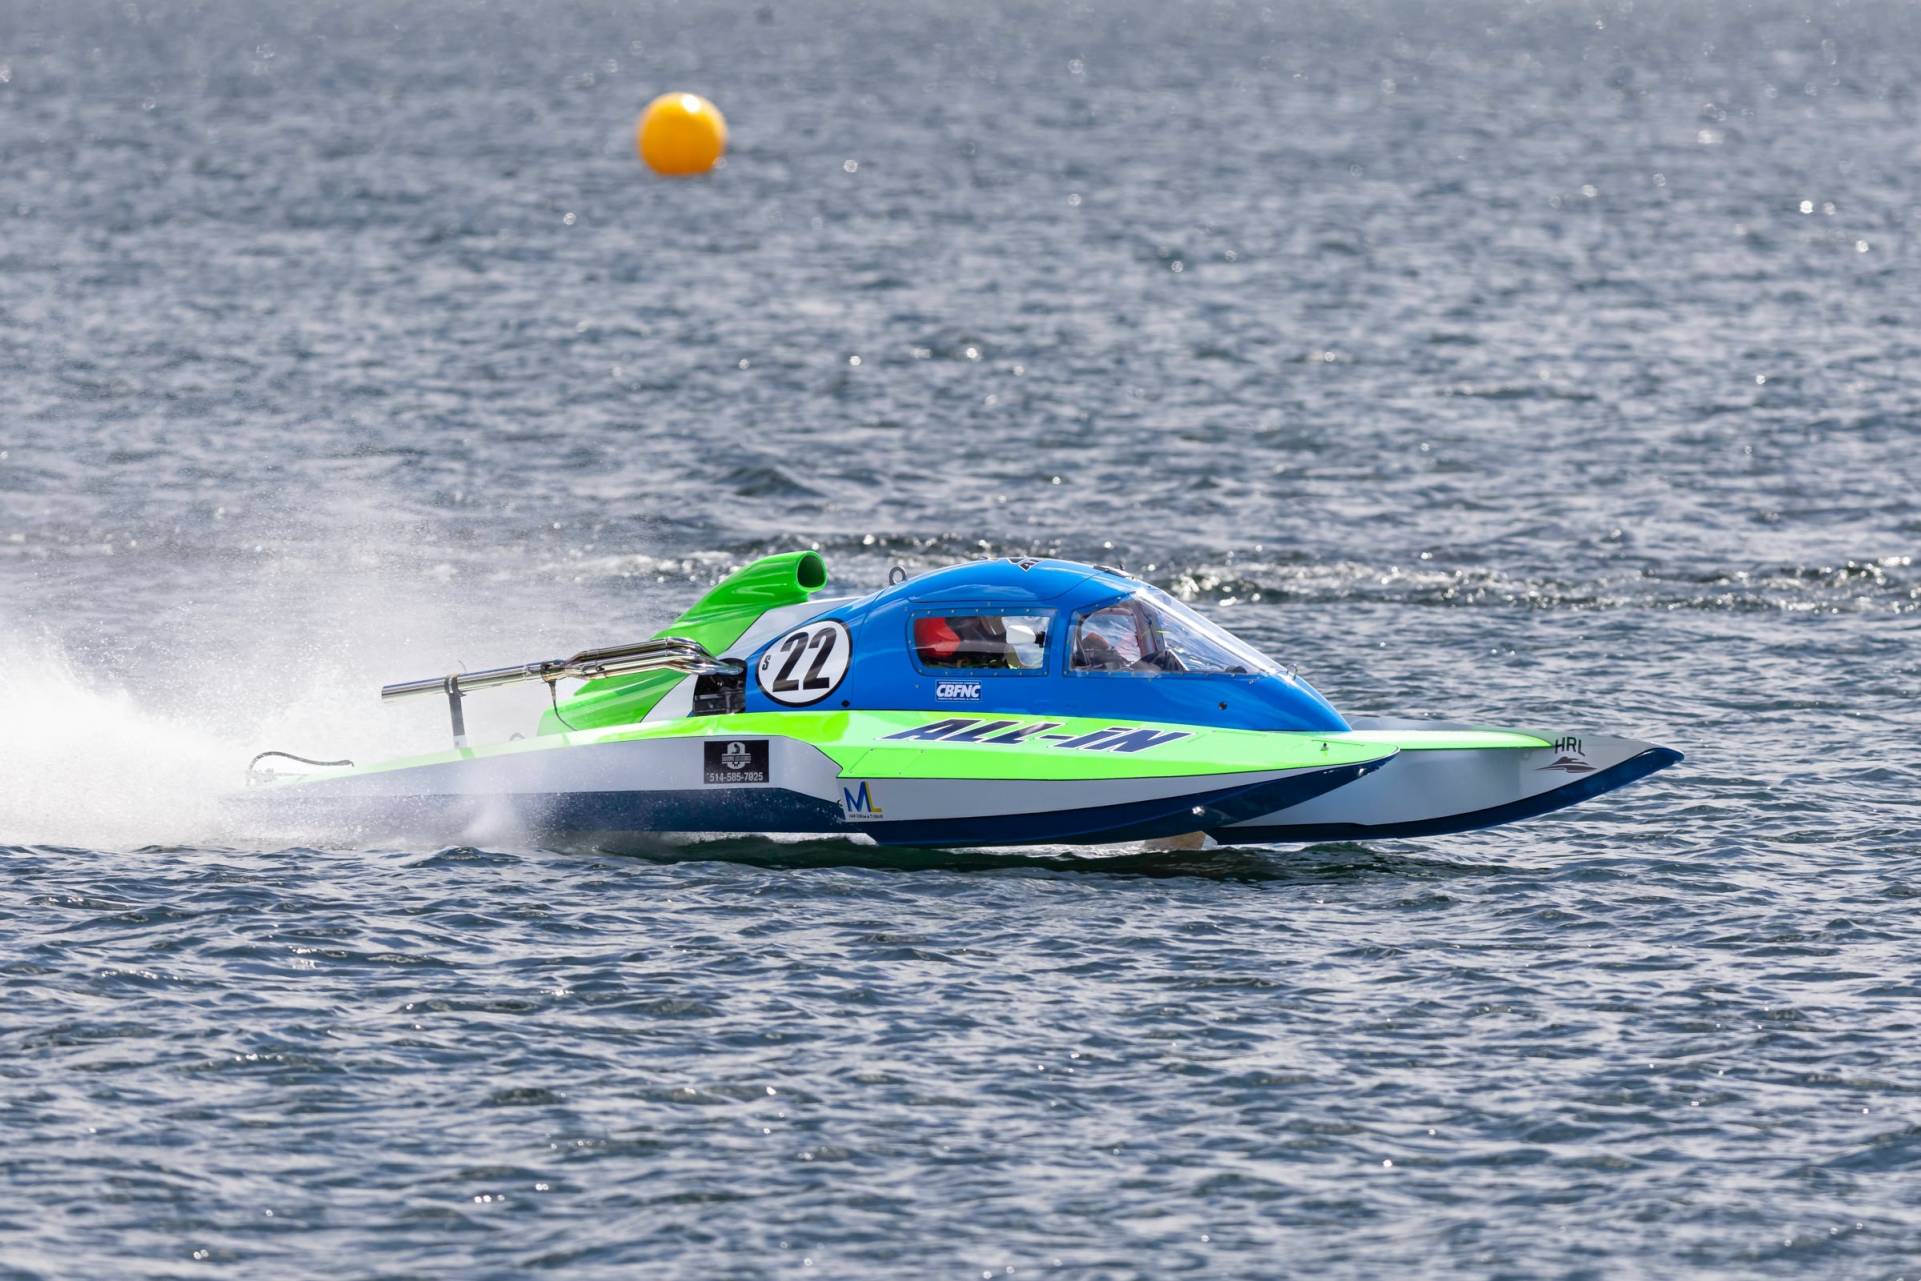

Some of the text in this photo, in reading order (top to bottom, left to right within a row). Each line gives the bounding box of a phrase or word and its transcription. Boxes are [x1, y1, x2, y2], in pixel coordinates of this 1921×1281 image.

[761, 627, 838, 693] S 22
[936, 684, 981, 698] CBFNC
[1554, 736, 1586, 757] HRL
[843, 781, 882, 813] ML
